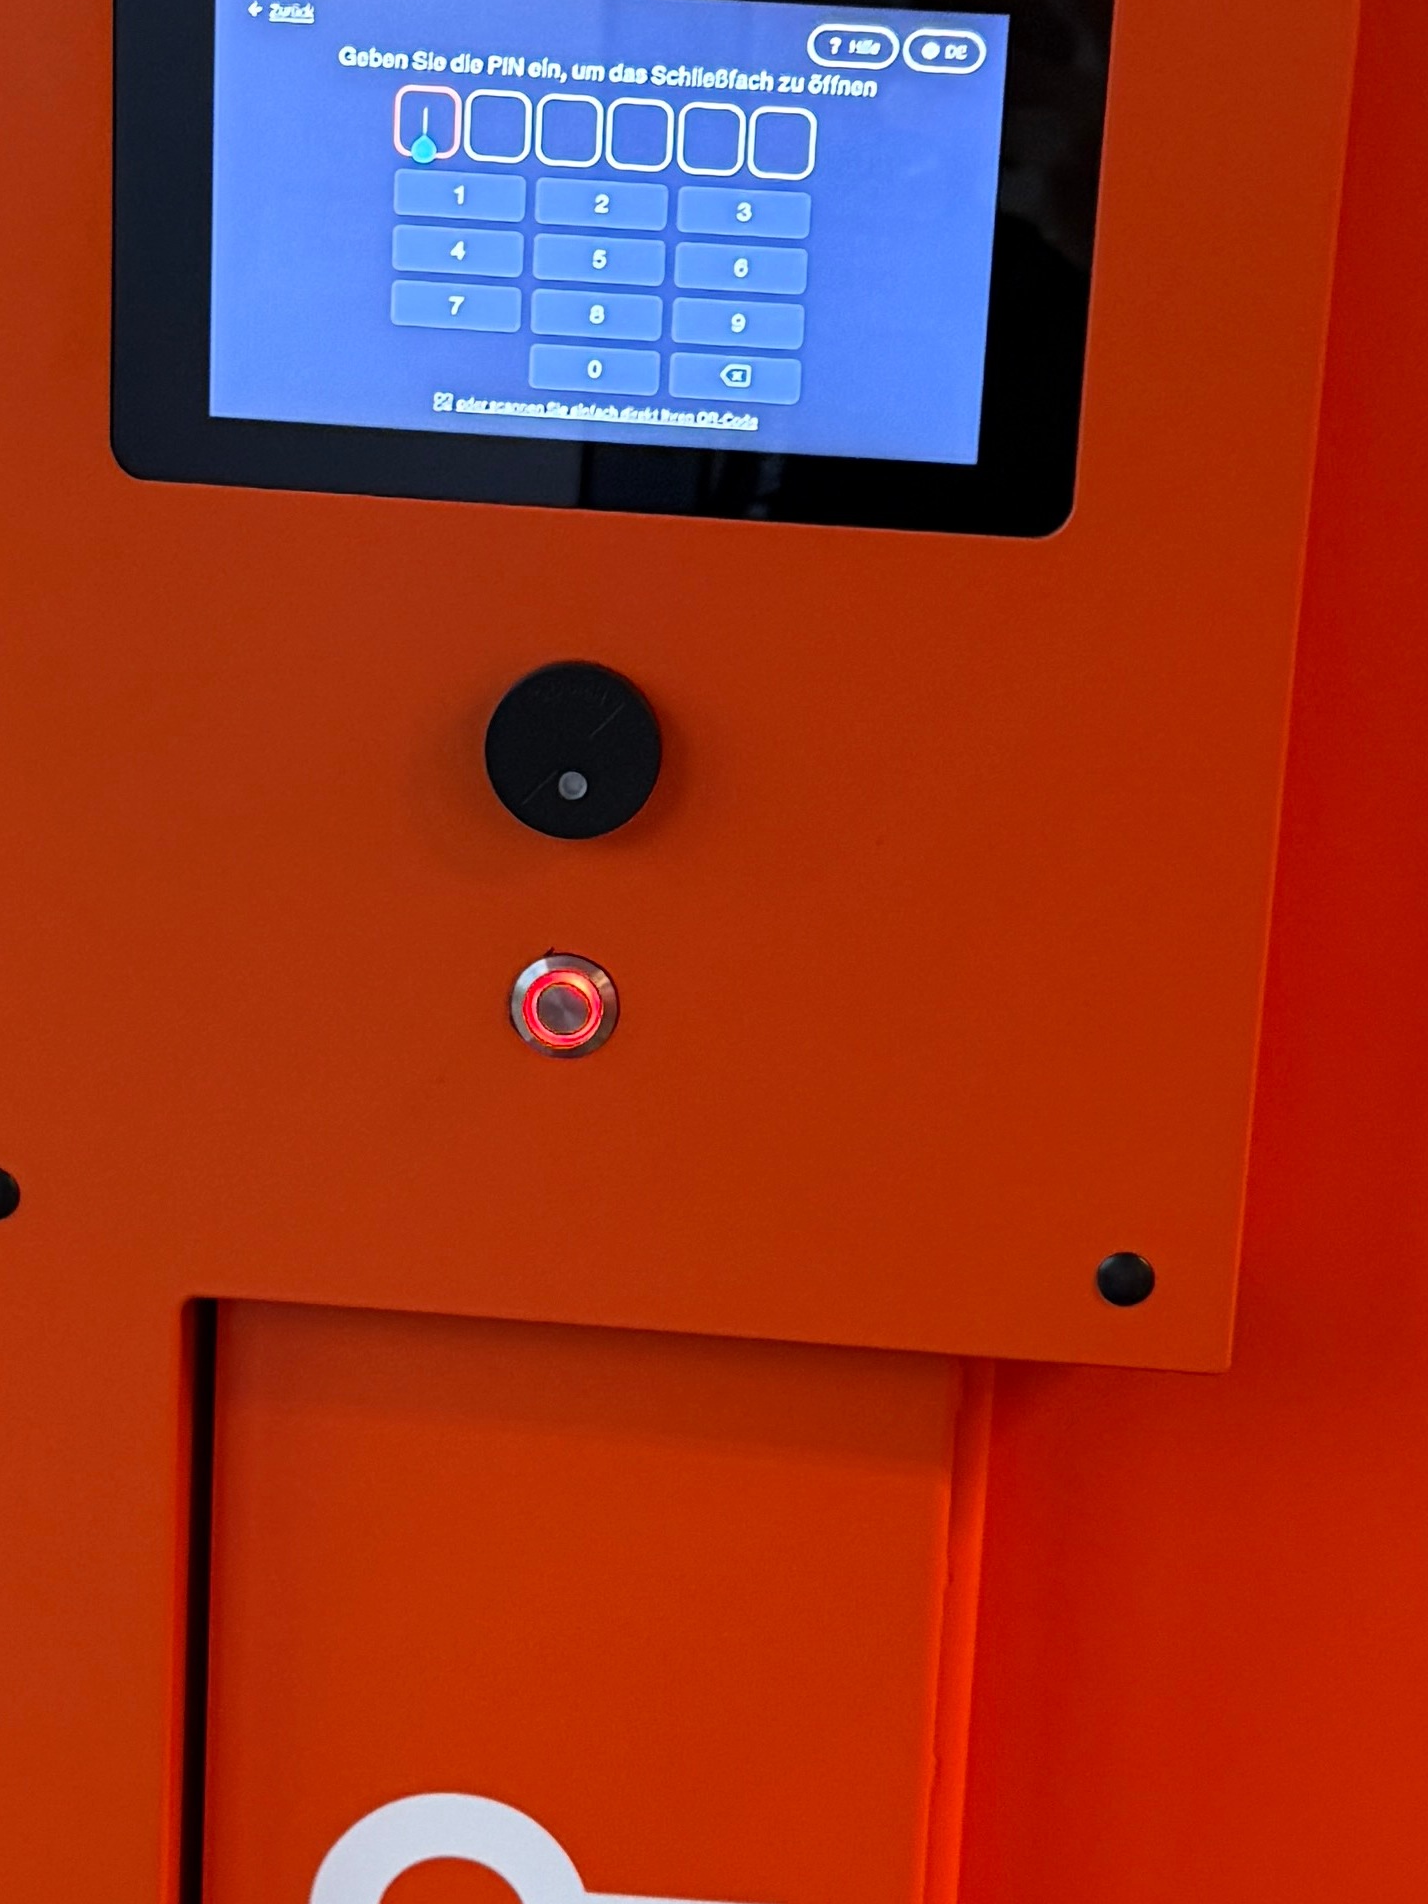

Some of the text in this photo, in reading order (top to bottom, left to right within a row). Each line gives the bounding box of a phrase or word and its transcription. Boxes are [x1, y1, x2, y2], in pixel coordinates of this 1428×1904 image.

[338, 46, 878, 98] Geben Sie die PIN ein, um das Schließfach zu öffnen
[453, 184, 465, 205] 1
[594, 194, 610, 214] 2
[736, 202, 752, 222] 3
[450, 241, 466, 261] 4
[592, 249, 607, 269] 5
[733, 258, 749, 278] 6
[448, 295, 465, 315] 7
[589, 304, 605, 324] 8
[731, 313, 746, 333] 9
[587, 359, 602, 379] 0
